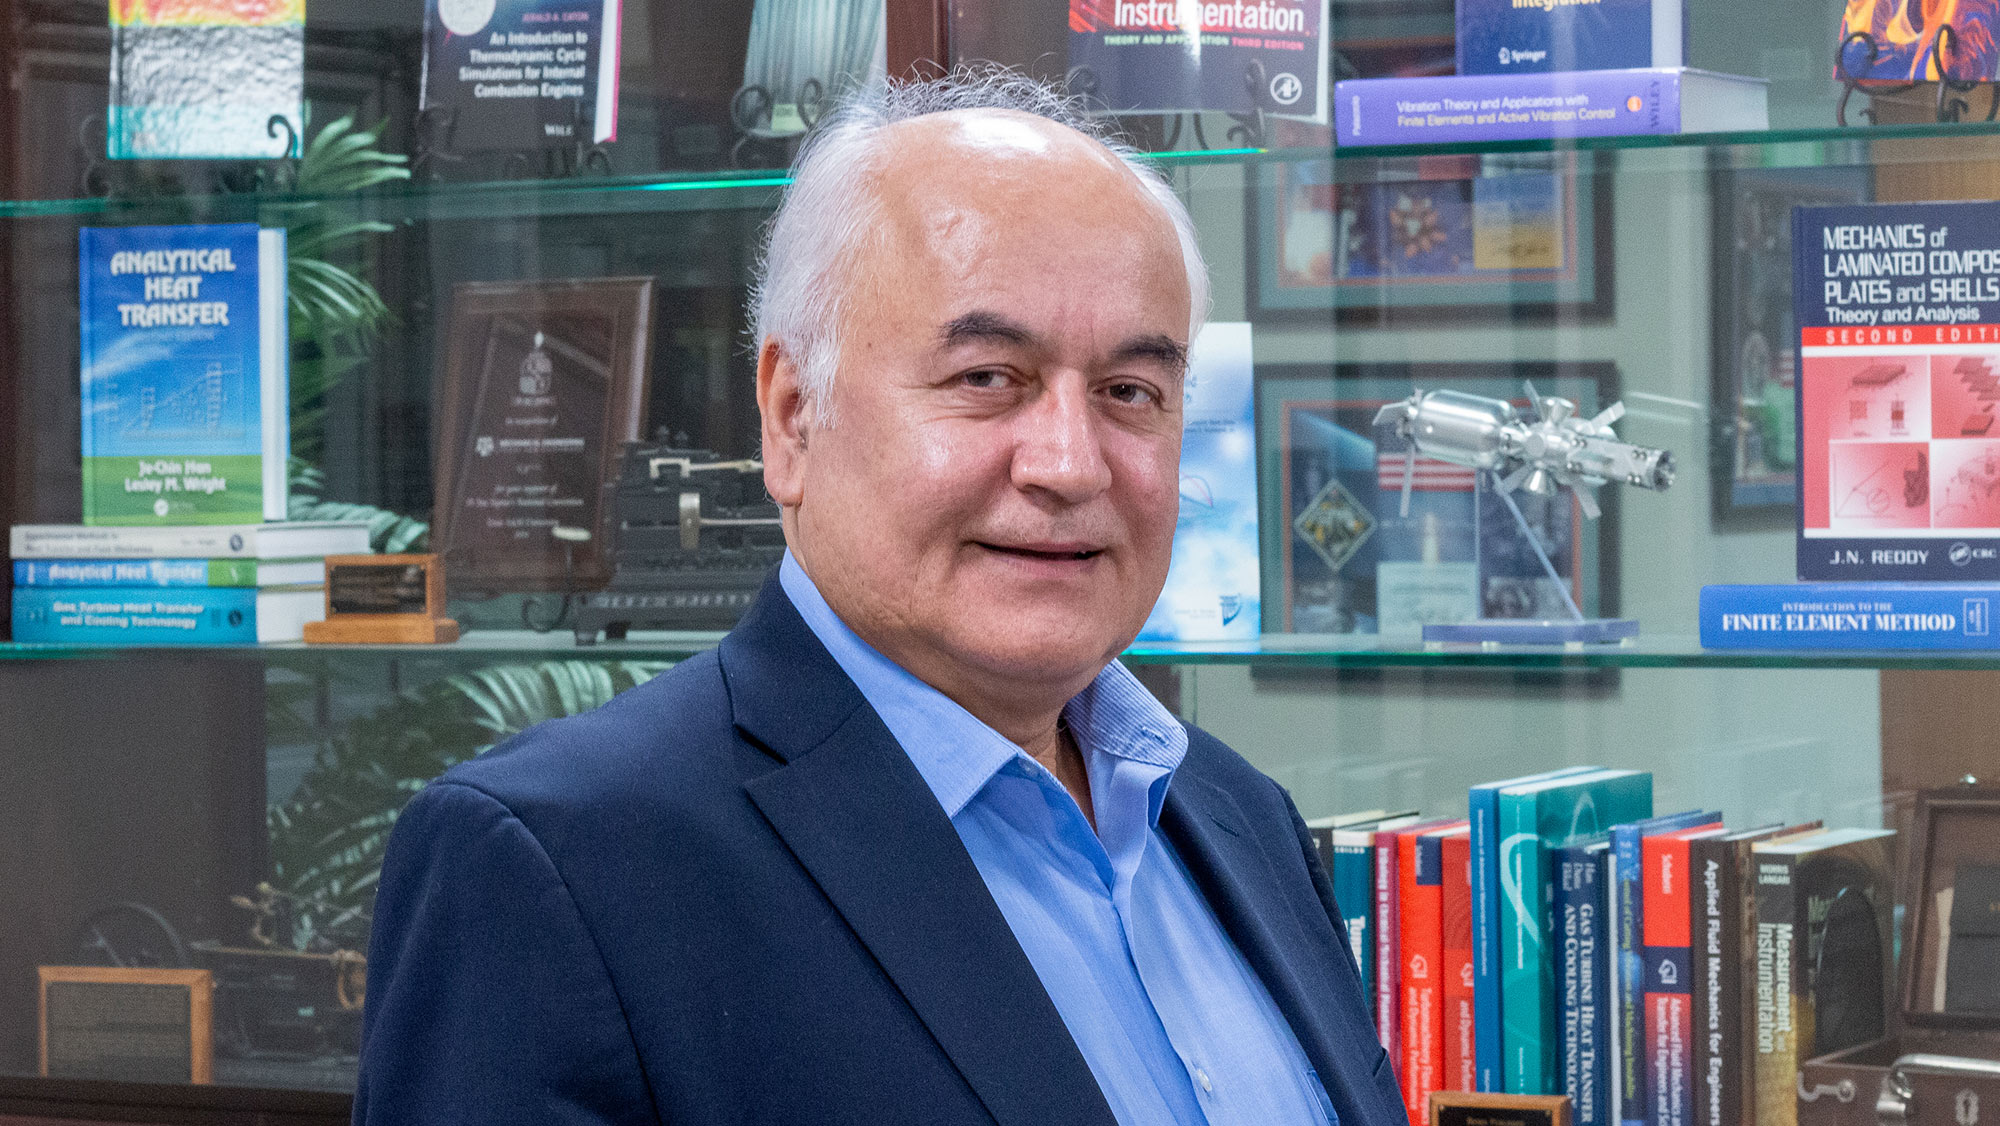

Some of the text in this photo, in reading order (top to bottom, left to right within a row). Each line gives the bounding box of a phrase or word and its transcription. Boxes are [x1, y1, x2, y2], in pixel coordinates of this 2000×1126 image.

[489, 31, 588, 46] An Introduction to
[1104, 35, 1140, 46] THEORY
[1142, 35, 1163, 45] AND
[1232, 37, 1262, 48] THIRD
[1264, 39, 1304, 50] EDITION
[469, 48, 587, 65] Thermodynamic Cycle
[1511, 49, 1546, 63] Springer
[459, 65, 586, 81] Simulations for Internal
[474, 83, 584, 99] Combustion Engines
[1397, 94, 1589, 113] Vibration Theory and Applications with
[1398, 108, 1616, 127] Finite Elements and Active Vibration Control
[544, 124, 573, 136] WILE
[1823, 224, 1948, 250] MECHANICS of
[110, 248, 236, 276] ANALYTICAL
[1824, 251, 1924, 277] LAMINATED
[144, 275, 202, 300] HEAT
[1825, 278, 1999, 305] PLATES and SHELLS
[117, 302, 229, 327] TRANSFER
[1825, 304, 1980, 326] Theory and Analysis
[1826, 328, 1913, 344] SECOND
[183, 476, 226, 495] Wright
[1829, 549, 1929, 565] J.N. REDDY
[53, 601, 204, 614] Gas Turbine Heat Transfer
[1783, 602, 1892, 612] INTRODUCTION TO THE
[60, 616, 83, 626] and
[84, 615, 128, 628] Cooling
[131, 616, 196, 630] Technology
[1722, 614, 1782, 632] FINITE
[1786, 613, 1872, 632] ELEMENT
[1875, 613, 1956, 631] METHOD
[1564, 903, 1577, 935] AND
[1564, 938, 1579, 1005] COOLING
[1776, 923, 1793, 1033] Measurement
[1704, 859, 1723, 1126] Applied Fluid Mechanics for Engineers
[1758, 923, 1776, 1053] Instrumentation
[1579, 903, 1595, 1122] GAS TURBINE HEAT TRANSFER
[1657, 998, 1669, 1033] Transfer
[1670, 998, 1682, 1042] Advanced
[1657, 1034, 1669, 1048] for
[1671, 1044, 1683, 1066] Fluid
[1461, 1059, 1472, 1091] Perform
[1655, 1049, 1670, 1094] Engineers
[1670, 1068, 1683, 1114] Mechanics
[1657, 1095, 1669, 1113] and
